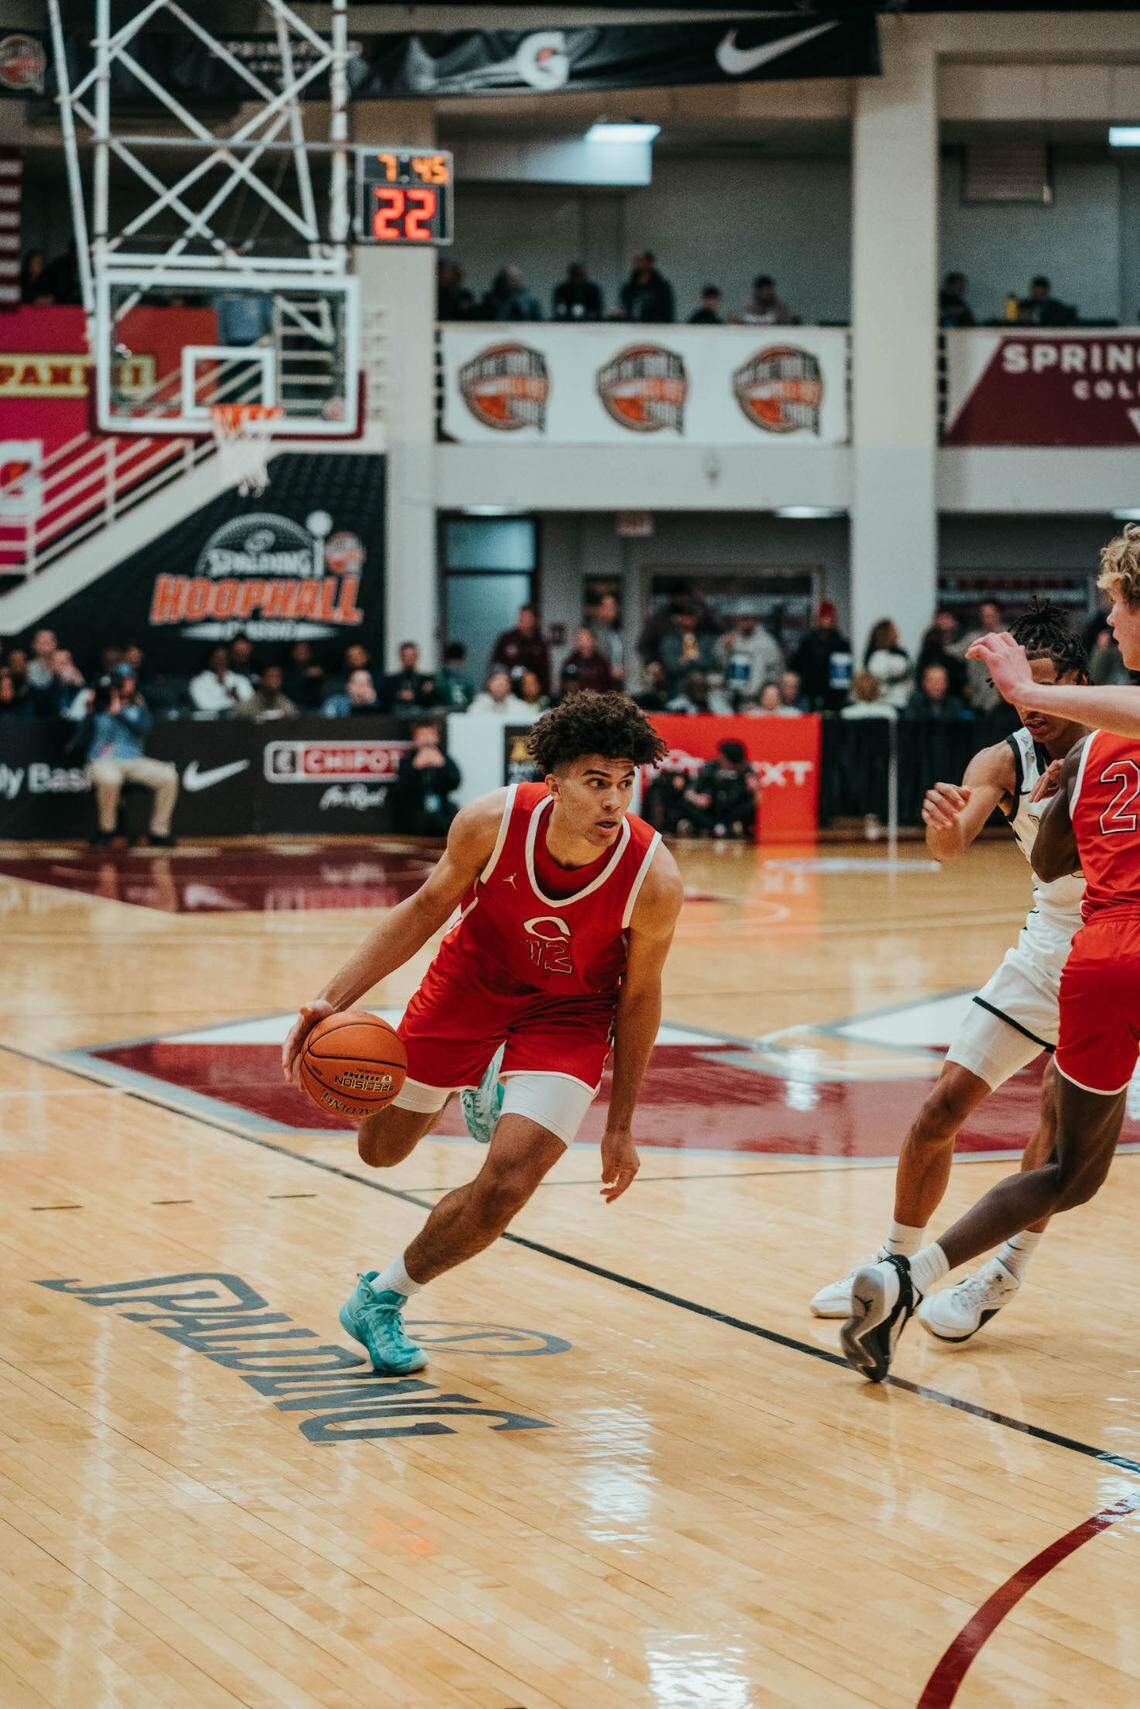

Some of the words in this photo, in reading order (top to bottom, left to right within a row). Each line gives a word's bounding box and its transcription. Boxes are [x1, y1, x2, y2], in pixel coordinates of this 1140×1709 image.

[373, 187, 436, 239] 22
[1002, 343, 1140, 374] SPRIN
[1073, 379, 1140, 401] COL
[150, 573, 364, 626] HOOPHALL
[526, 939, 573, 975] 12
[31, 1271, 556, 1442] SPALDING
